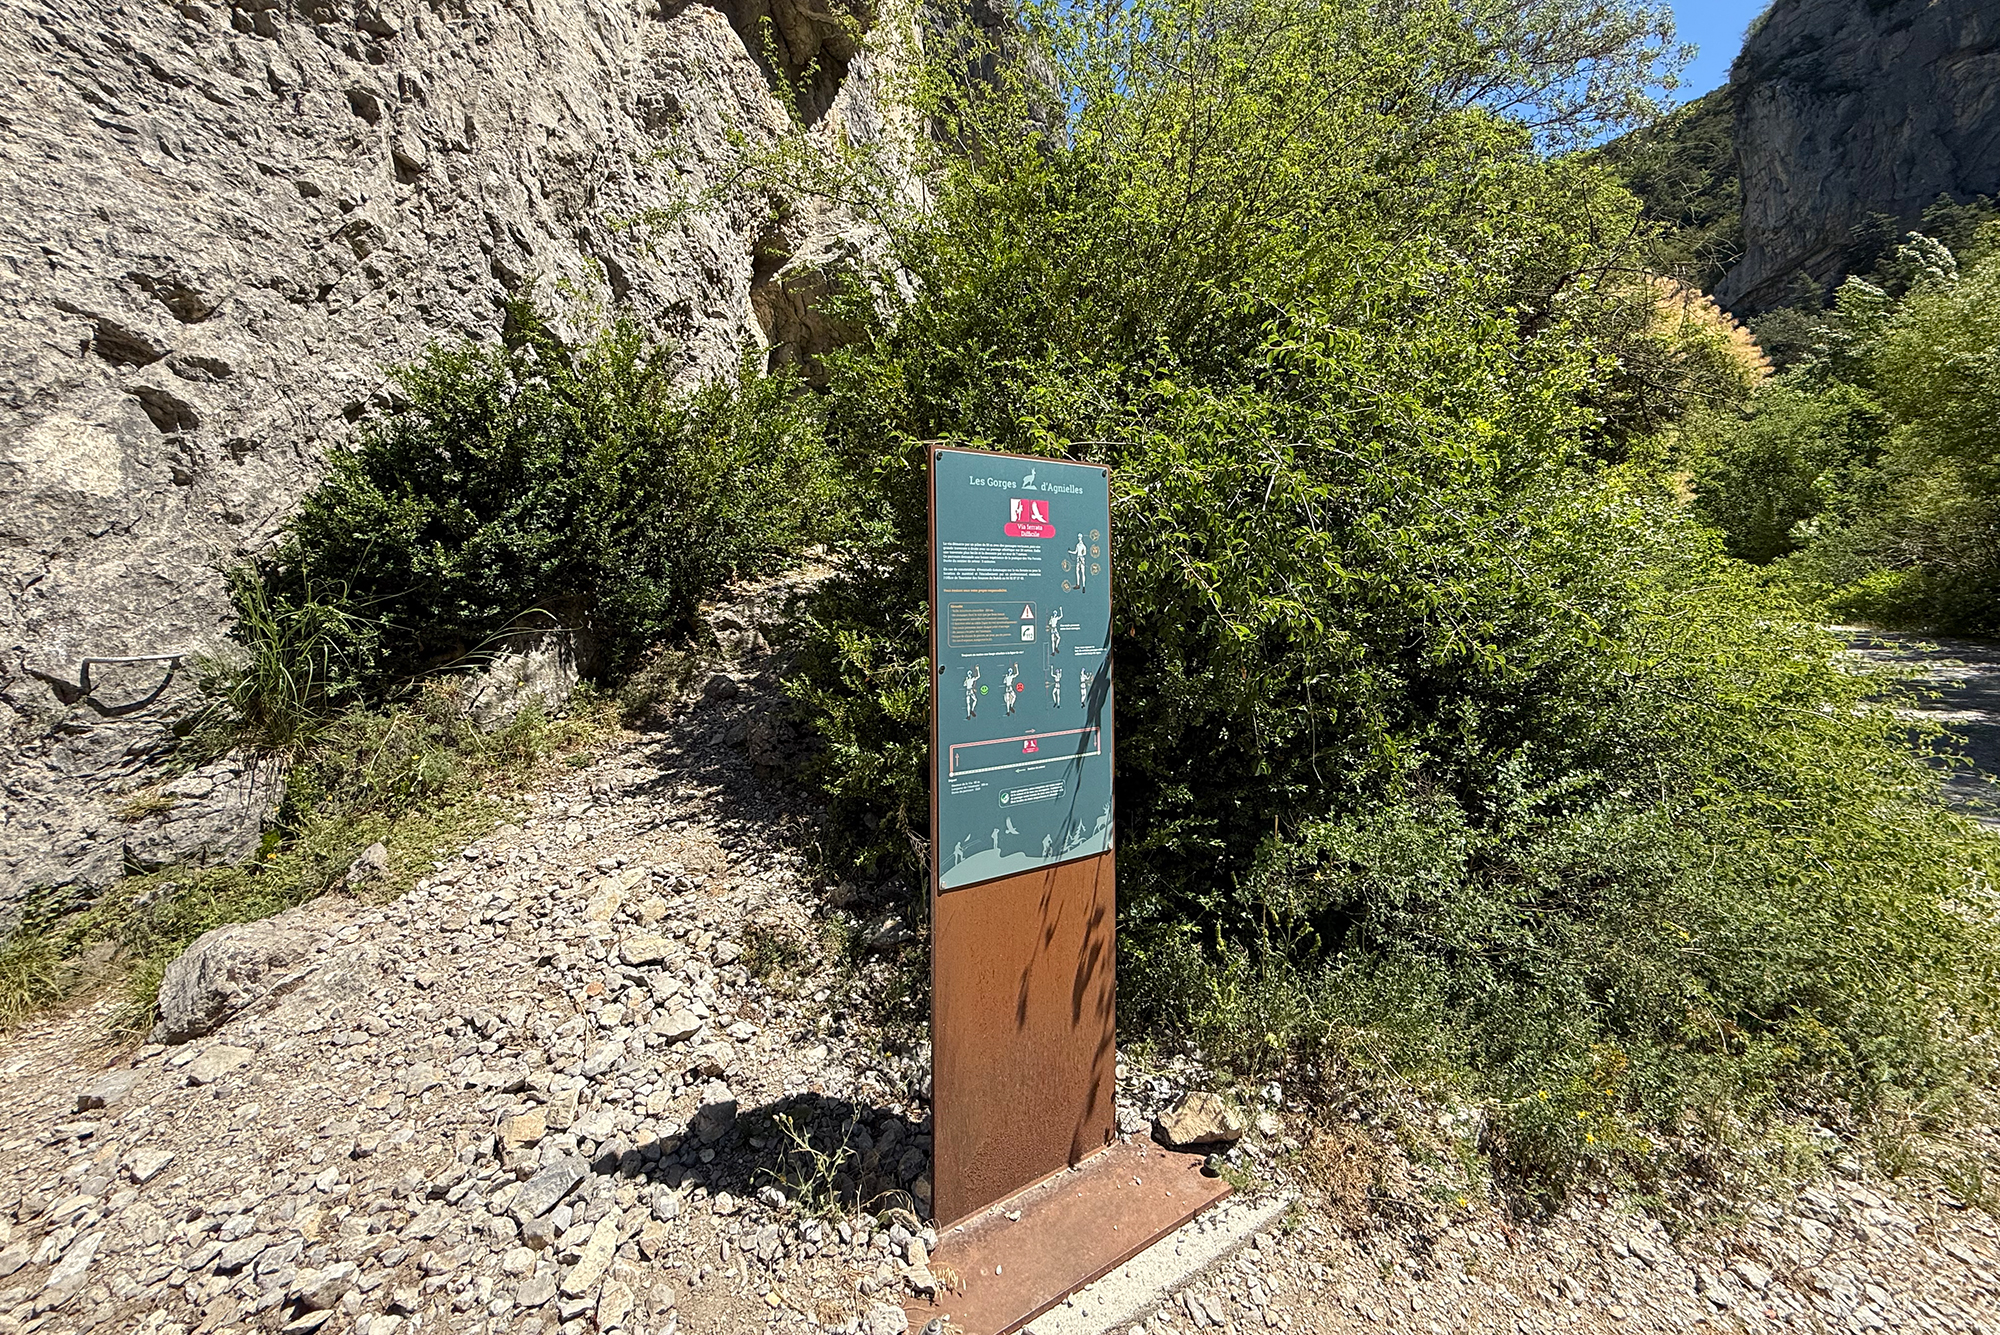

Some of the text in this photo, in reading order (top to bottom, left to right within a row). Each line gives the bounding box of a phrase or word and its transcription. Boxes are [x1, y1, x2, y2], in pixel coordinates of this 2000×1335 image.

[969, 476, 1084, 495] Les Gorges d'Agnielles
[1020, 530, 1040, 538] Difficile
